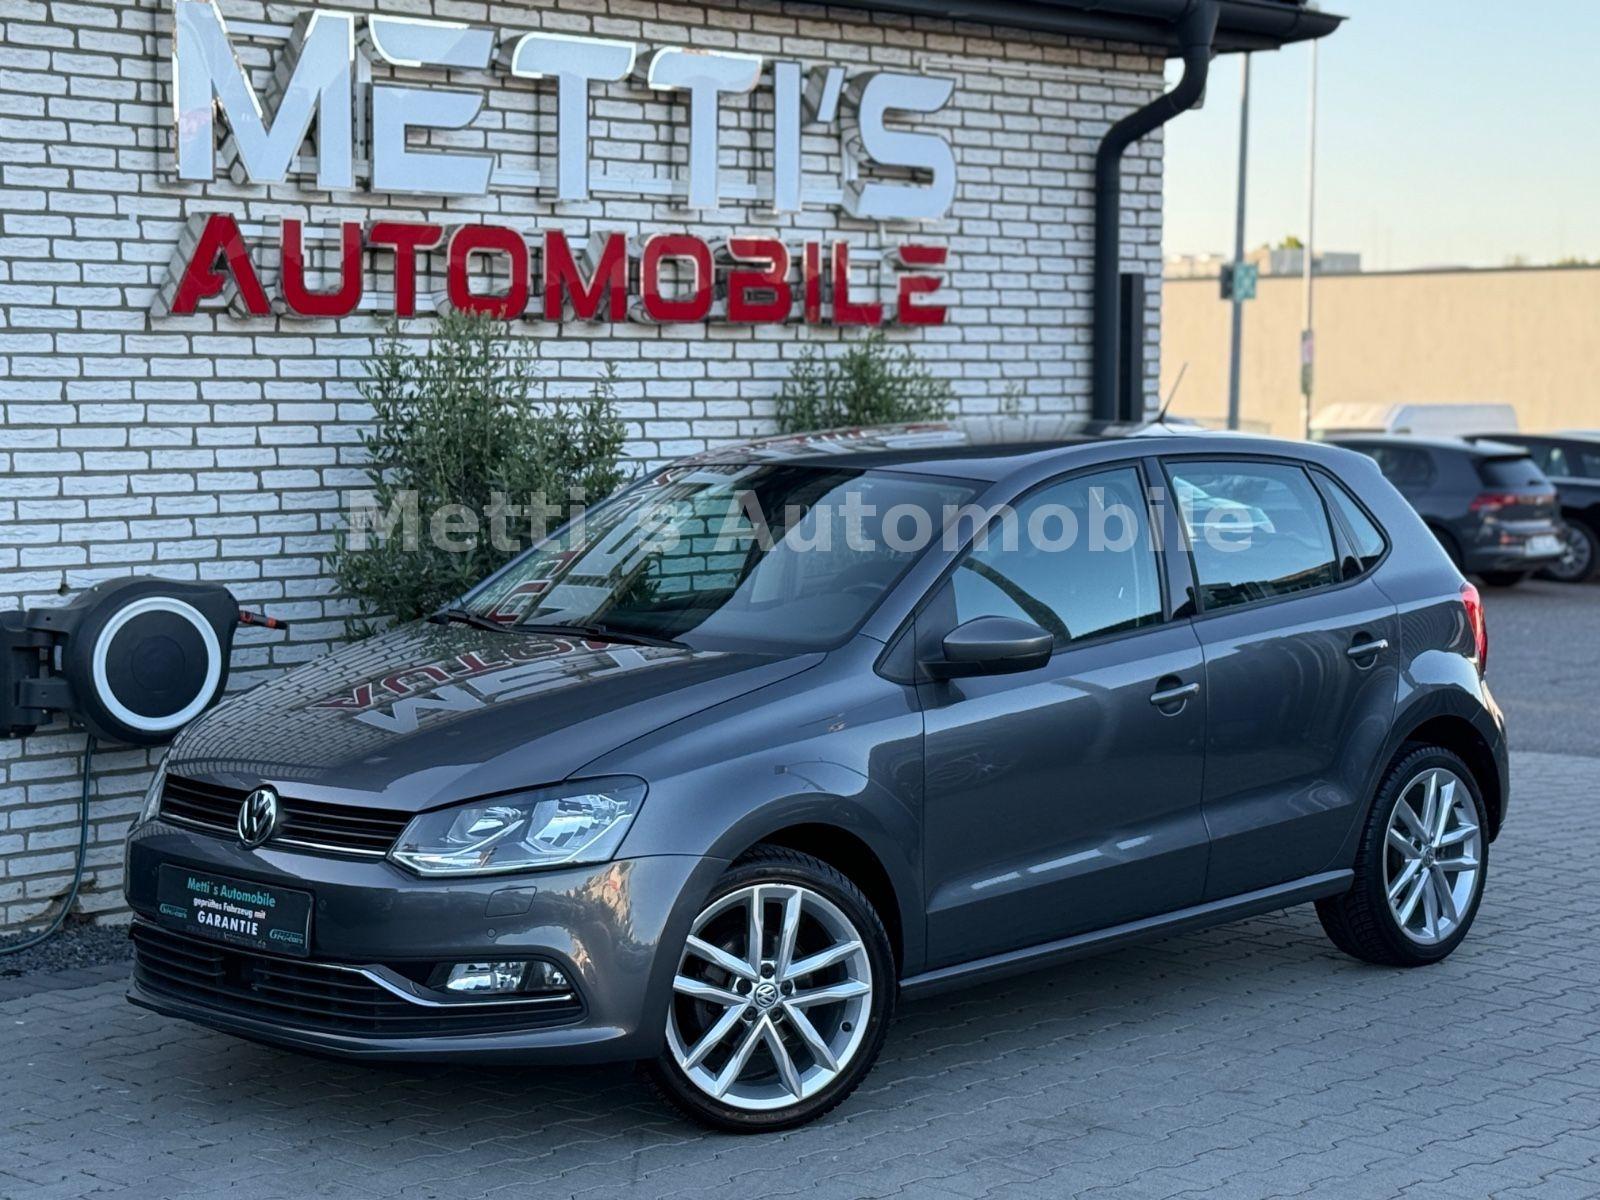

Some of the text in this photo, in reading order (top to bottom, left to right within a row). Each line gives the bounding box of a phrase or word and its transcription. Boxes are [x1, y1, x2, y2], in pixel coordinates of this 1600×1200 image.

[172, 0, 957, 221] METTI'S
[170, 212, 950, 327] AUTOMOBILE
[220, 885, 277, 908] Automobile
[197, 910, 259, 936] GARANTIE
[223, 902, 253, 919] Fahrzeug
